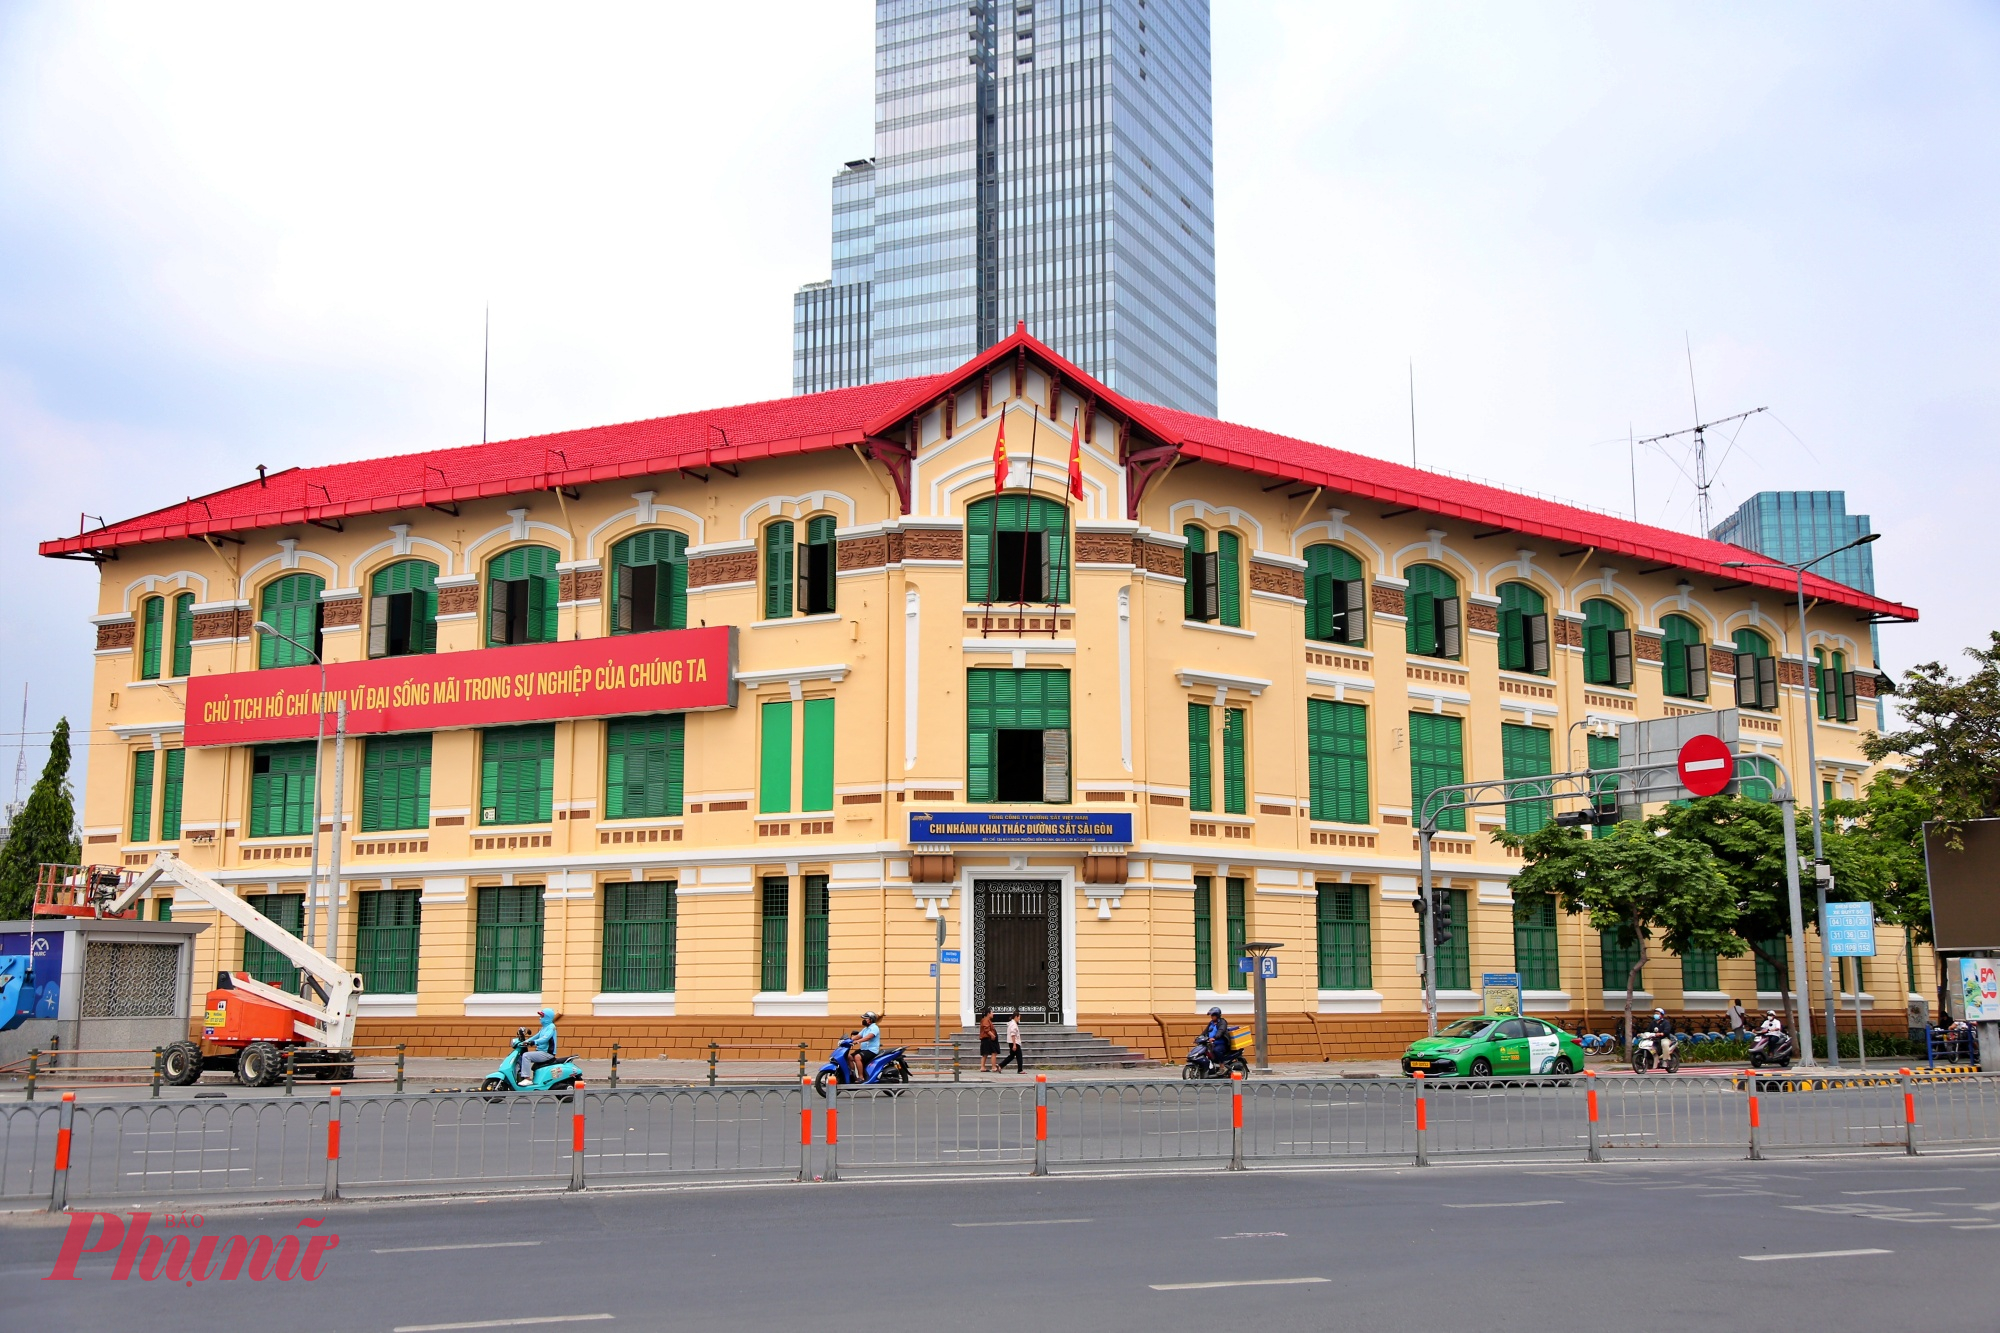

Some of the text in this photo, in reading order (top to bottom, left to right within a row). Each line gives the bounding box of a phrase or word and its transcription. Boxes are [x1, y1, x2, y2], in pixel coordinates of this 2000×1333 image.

[204, 694, 230, 723] CHỦ
[233, 697, 262, 724] TỊCH
[265, 689, 285, 718] HỒ
[286, 689, 310, 716] CHÍ
[351, 685, 366, 711] VĨ
[367, 686, 389, 713] ĐẠI
[393, 678, 430, 708] SỐNG
[433, 676, 460, 704] MÃI
[464, 676, 511, 702] TRONG
[515, 672, 535, 701] SỰ
[537, 665, 592, 697] NGHIỆP
[595, 659, 626, 690] CỦA
[630, 658, 683, 688] CHÚNG
[686, 658, 707, 683] TA
[929, 820, 1113, 834] CHI NHÁNH KHAI THÁC ĐƯỜNG SẮT SÀI GÒN
